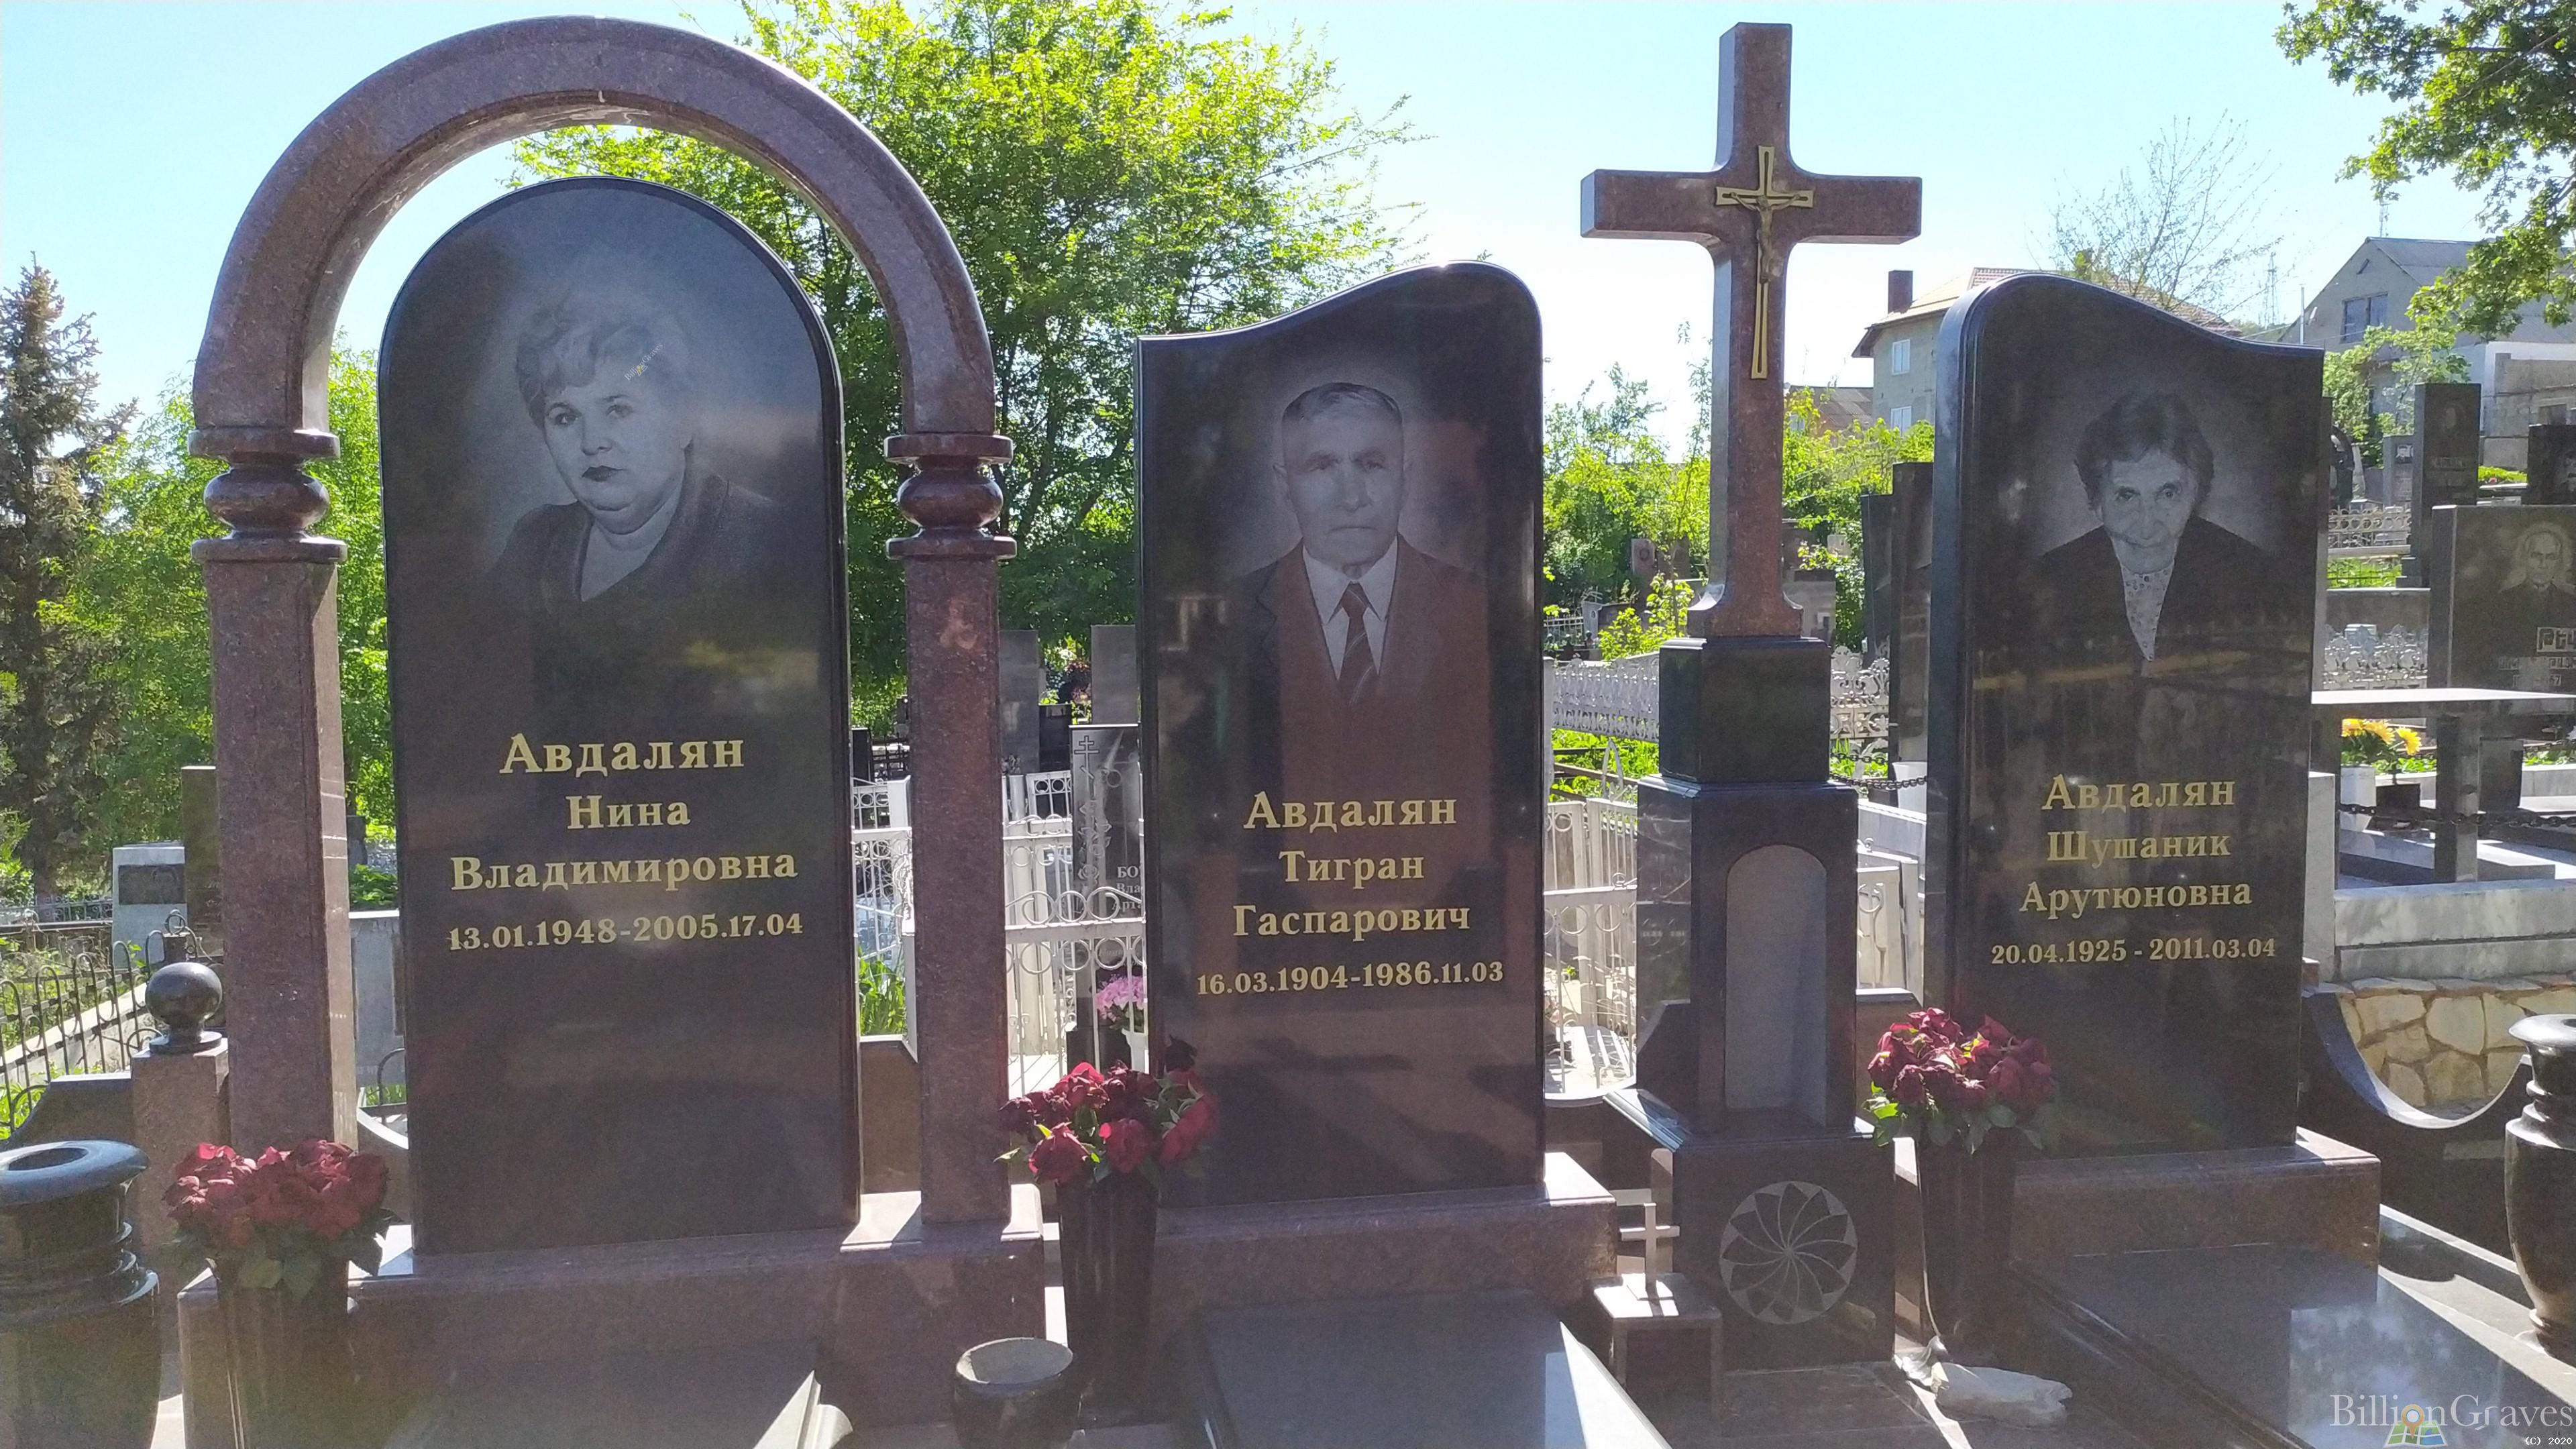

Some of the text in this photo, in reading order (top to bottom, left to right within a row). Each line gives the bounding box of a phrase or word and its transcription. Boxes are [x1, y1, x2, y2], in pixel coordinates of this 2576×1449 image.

[499, 733, 744, 777] Авдалян
[566, 795, 691, 829] Нина
[1244, 791, 1456, 833] Авдалян
[2041, 773, 2235, 813] Авдалян
[2046, 830, 2231, 869] Шушаник
[450, 854, 798, 892] Владимировна
[1117, 865, 1139, 878] БО
[1279, 850, 1424, 890] Тигран
[2019, 881, 2252, 920] Арутюновна
[449, 913, 803, 951] 13.01.1948-2005.17.04
[1233, 905, 1470, 942] Гаспарович
[1992, 939, 2127, 964] 20.04.1925
[2149, 937, 2275, 960] 2011.03.04
[1197, 961, 1503, 995] 16.03.1904-1986.11.03
